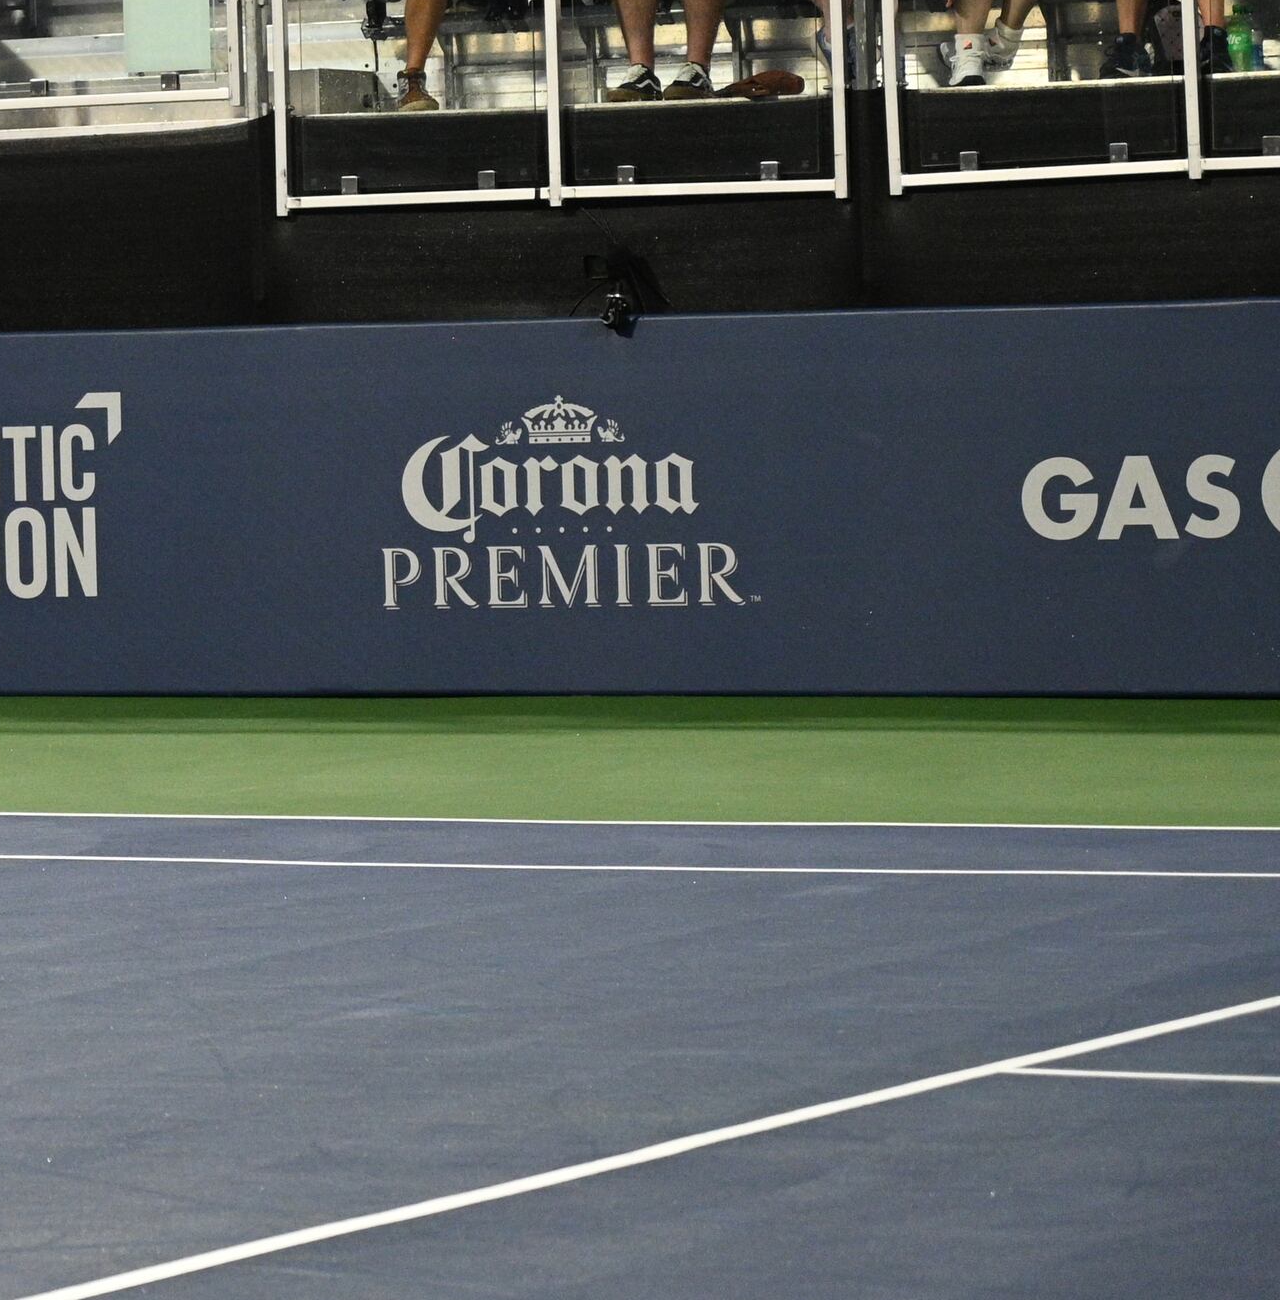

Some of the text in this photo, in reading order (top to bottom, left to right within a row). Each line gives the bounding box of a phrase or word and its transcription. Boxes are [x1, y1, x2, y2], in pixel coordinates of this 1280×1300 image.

[400, 432, 700, 544] Corona
[1021, 453, 1242, 541] GAS
[381, 541, 747, 611] PREMIER
